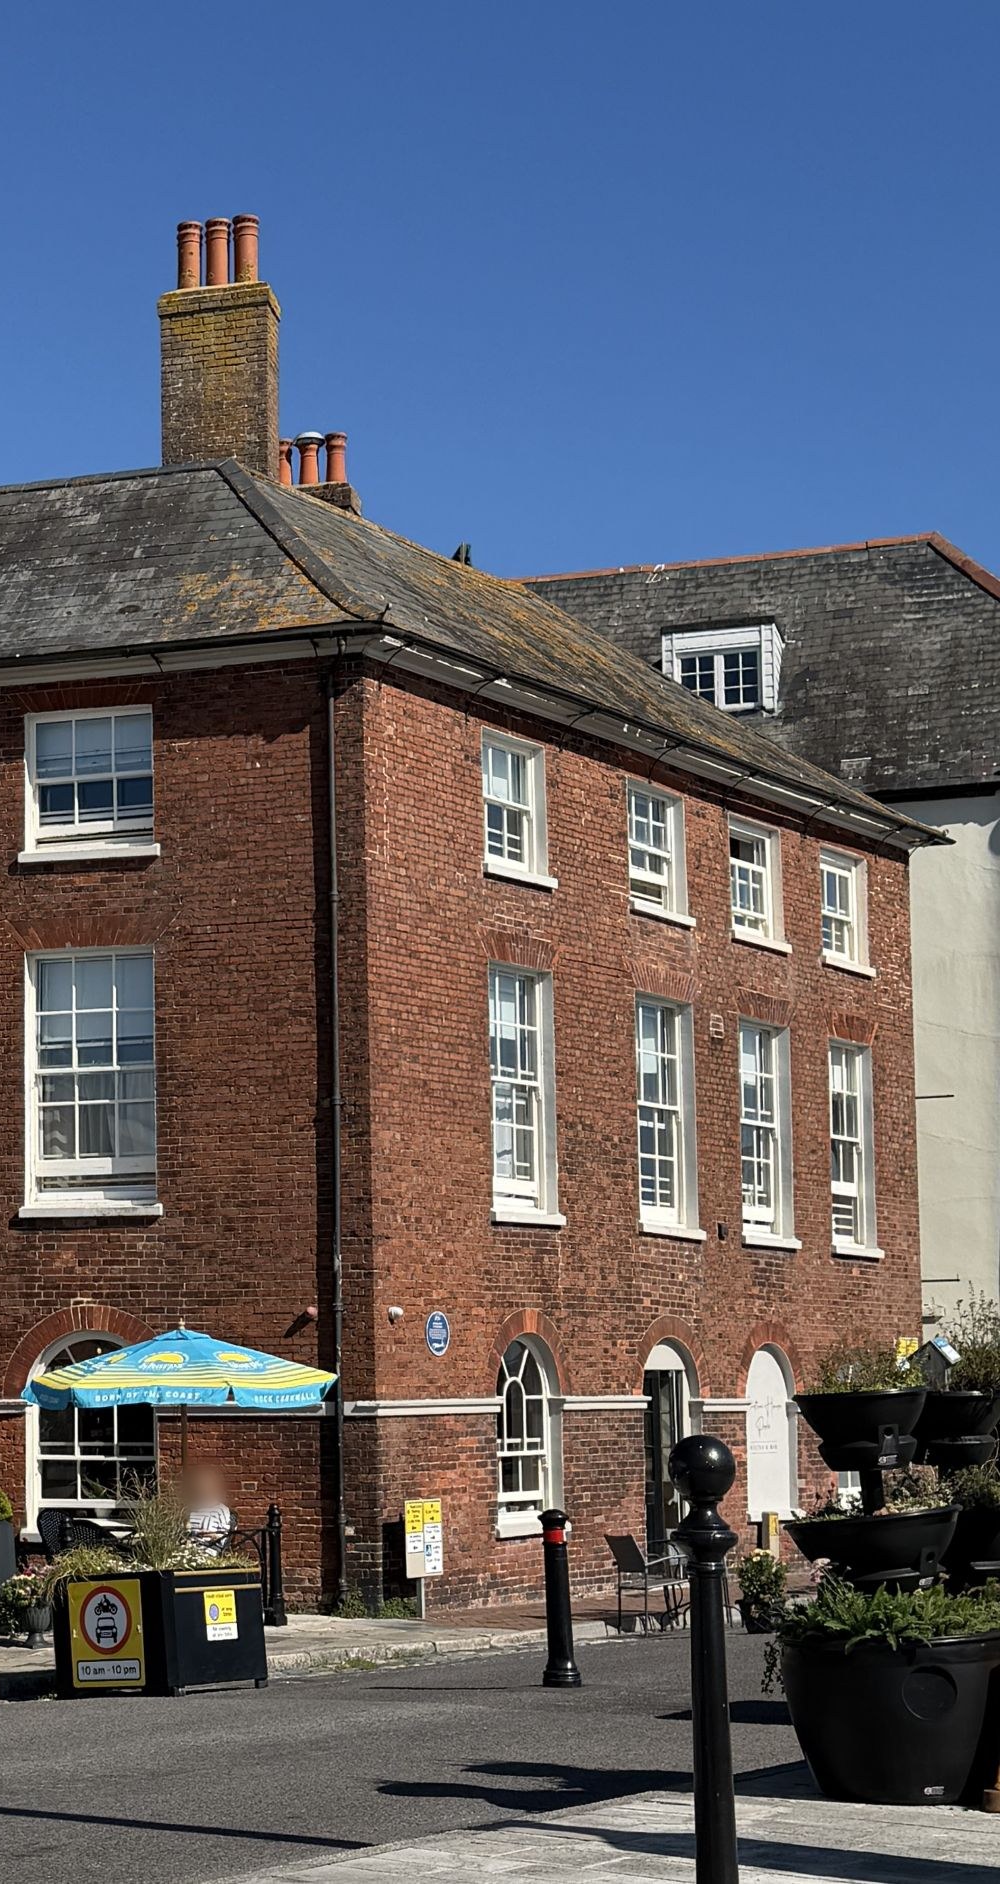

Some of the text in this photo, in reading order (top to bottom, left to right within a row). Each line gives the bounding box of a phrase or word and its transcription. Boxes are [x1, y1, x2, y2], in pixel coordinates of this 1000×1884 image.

[165, 1391, 202, 1400] COAST
[81, 1665, 91, 1676] 10
[93, 1667, 105, 1675] am
[111, 1665, 122, 1674] 10
[123, 1665, 137, 1675] pm
